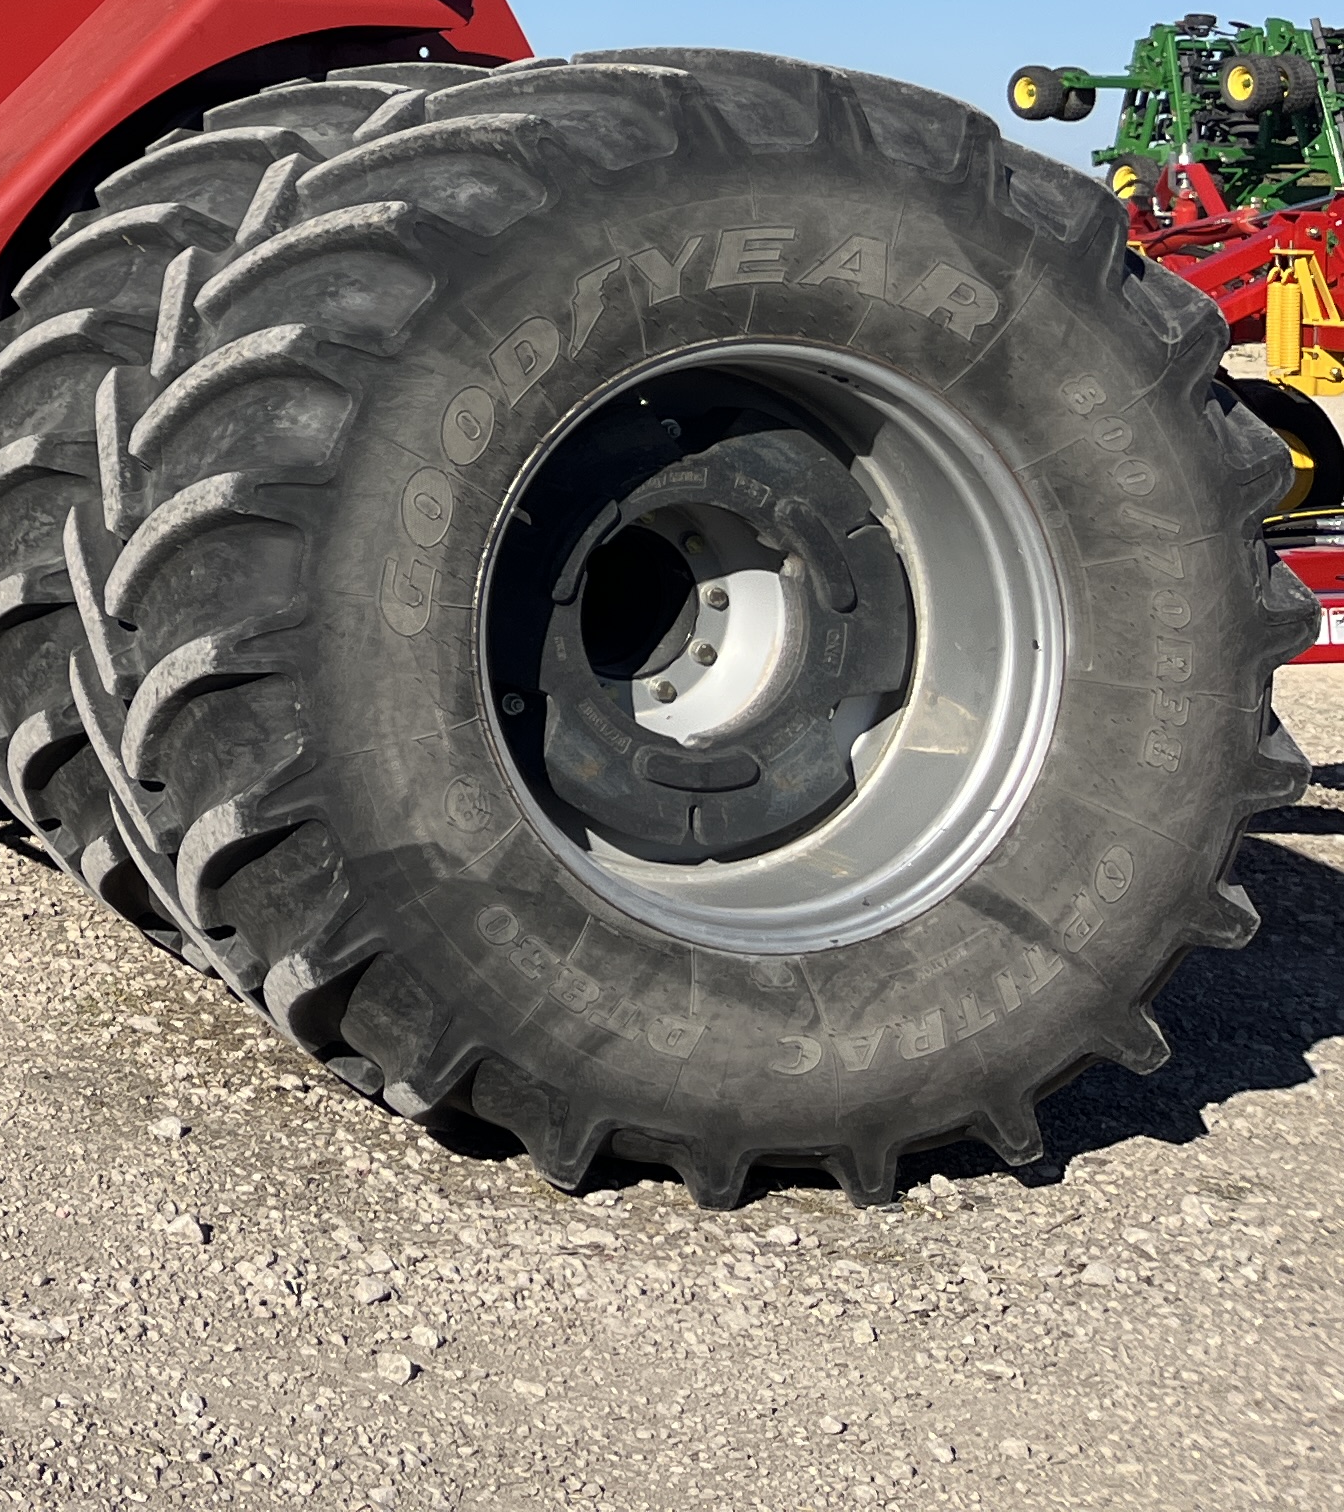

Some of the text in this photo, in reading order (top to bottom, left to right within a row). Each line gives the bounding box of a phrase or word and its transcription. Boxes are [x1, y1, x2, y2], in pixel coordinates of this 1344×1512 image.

[379, 226, 1001, 637] GOODYEAR
[1064, 374, 1192, 774] 800/70R38
[476, 904, 714, 1062] DT830
[771, 845, 1136, 1078] OPTITRAC
